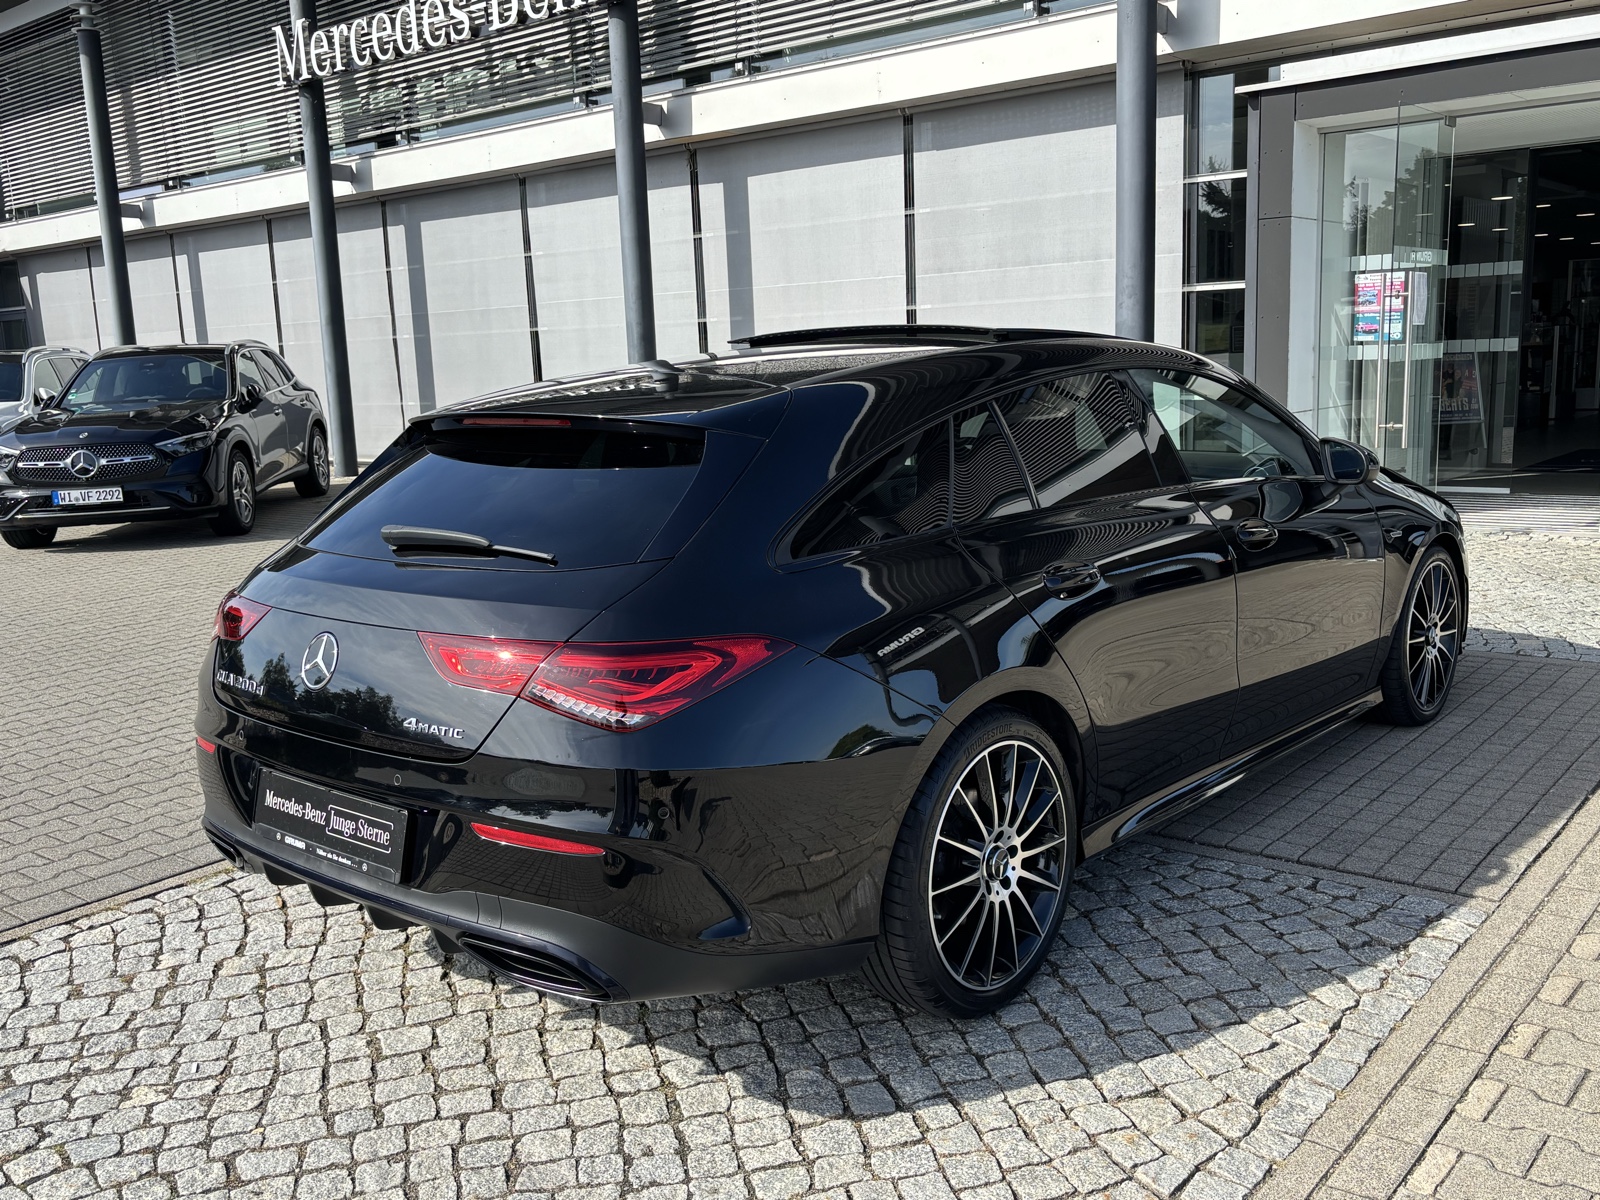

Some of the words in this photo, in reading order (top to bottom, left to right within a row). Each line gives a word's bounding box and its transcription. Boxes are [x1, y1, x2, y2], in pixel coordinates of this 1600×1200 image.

[272, 0, 600, 87] Mercedes-
[80, 490, 93, 502] VF
[95, 489, 121, 501] 2292
[403, 717, 465, 739] 4MATIC
[963, 722, 1013, 761] BRIDGESTONE
[264, 789, 327, 825] Mercedes-Benz
[328, 810, 356, 837] Junge
[357, 819, 390, 846] Sterne
